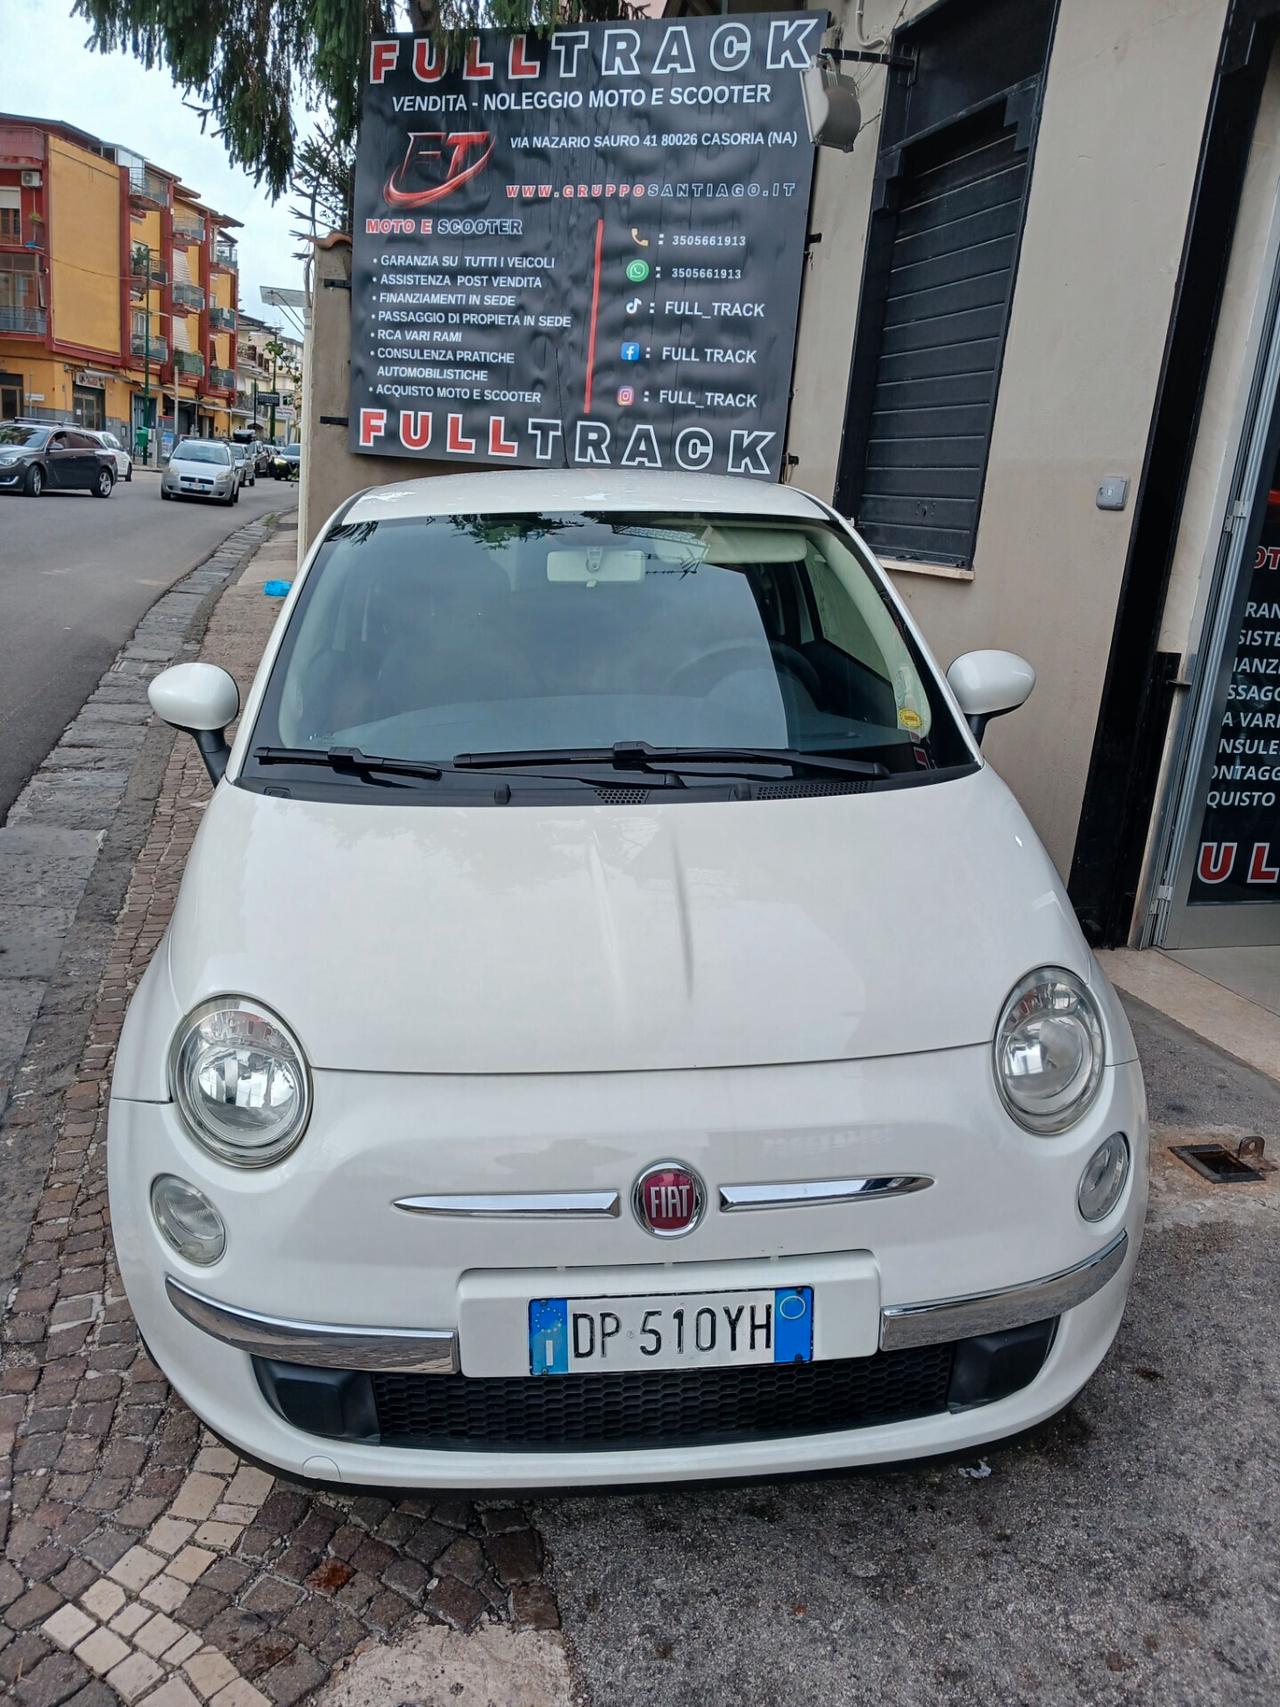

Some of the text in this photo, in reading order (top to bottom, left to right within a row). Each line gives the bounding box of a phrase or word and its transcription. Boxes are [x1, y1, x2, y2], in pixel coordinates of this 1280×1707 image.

[392, 94, 467, 112] VENDITA
[484, 90, 582, 110] NOLEGGIO
[588, 88, 646, 108] MOTO
[651, 88, 664, 105] E
[669, 84, 771, 105] SCOOTER
[510, 131, 798, 148] VIA NAZARIO SAURO 41 80026 CASORIA (NA)
[505, 183, 796, 198] WWW.GRUPPOSANTIAGO.IT
[365, 218, 523, 234] MOTO E SCOOTER
[672, 235, 746, 246] 3505661913
[380, 255, 555, 268] GARANZIA SU TUTTI I VEICOLI
[380, 274, 542, 288] ASSISTENZA POST VENDITA
[671, 268, 742, 279] 3505661913
[379, 293, 516, 306] FINANZIAMENTI IN SEDE
[664, 301, 765, 319] FULL_TRACK
[378, 311, 572, 327] PASSAGGIO DI PROPIETA IN SEDE
[377, 330, 462, 342] RCA VARI RAMI
[377, 348, 515, 364] CONSULENZA PRATICHE
[662, 347, 700, 361] FULL
[704, 348, 757, 364] TRACK
[376, 366, 489, 381] AUTOMOBILISTICHE
[376, 384, 542, 403] ACQUISTO MOTO E SCOOTER
[659, 390, 758, 408] FULL_TRACK
[358, 408, 775, 475] FULLTRACK
[649, 1184, 690, 1218] FIAT
[572, 1311, 622, 1359] DP
